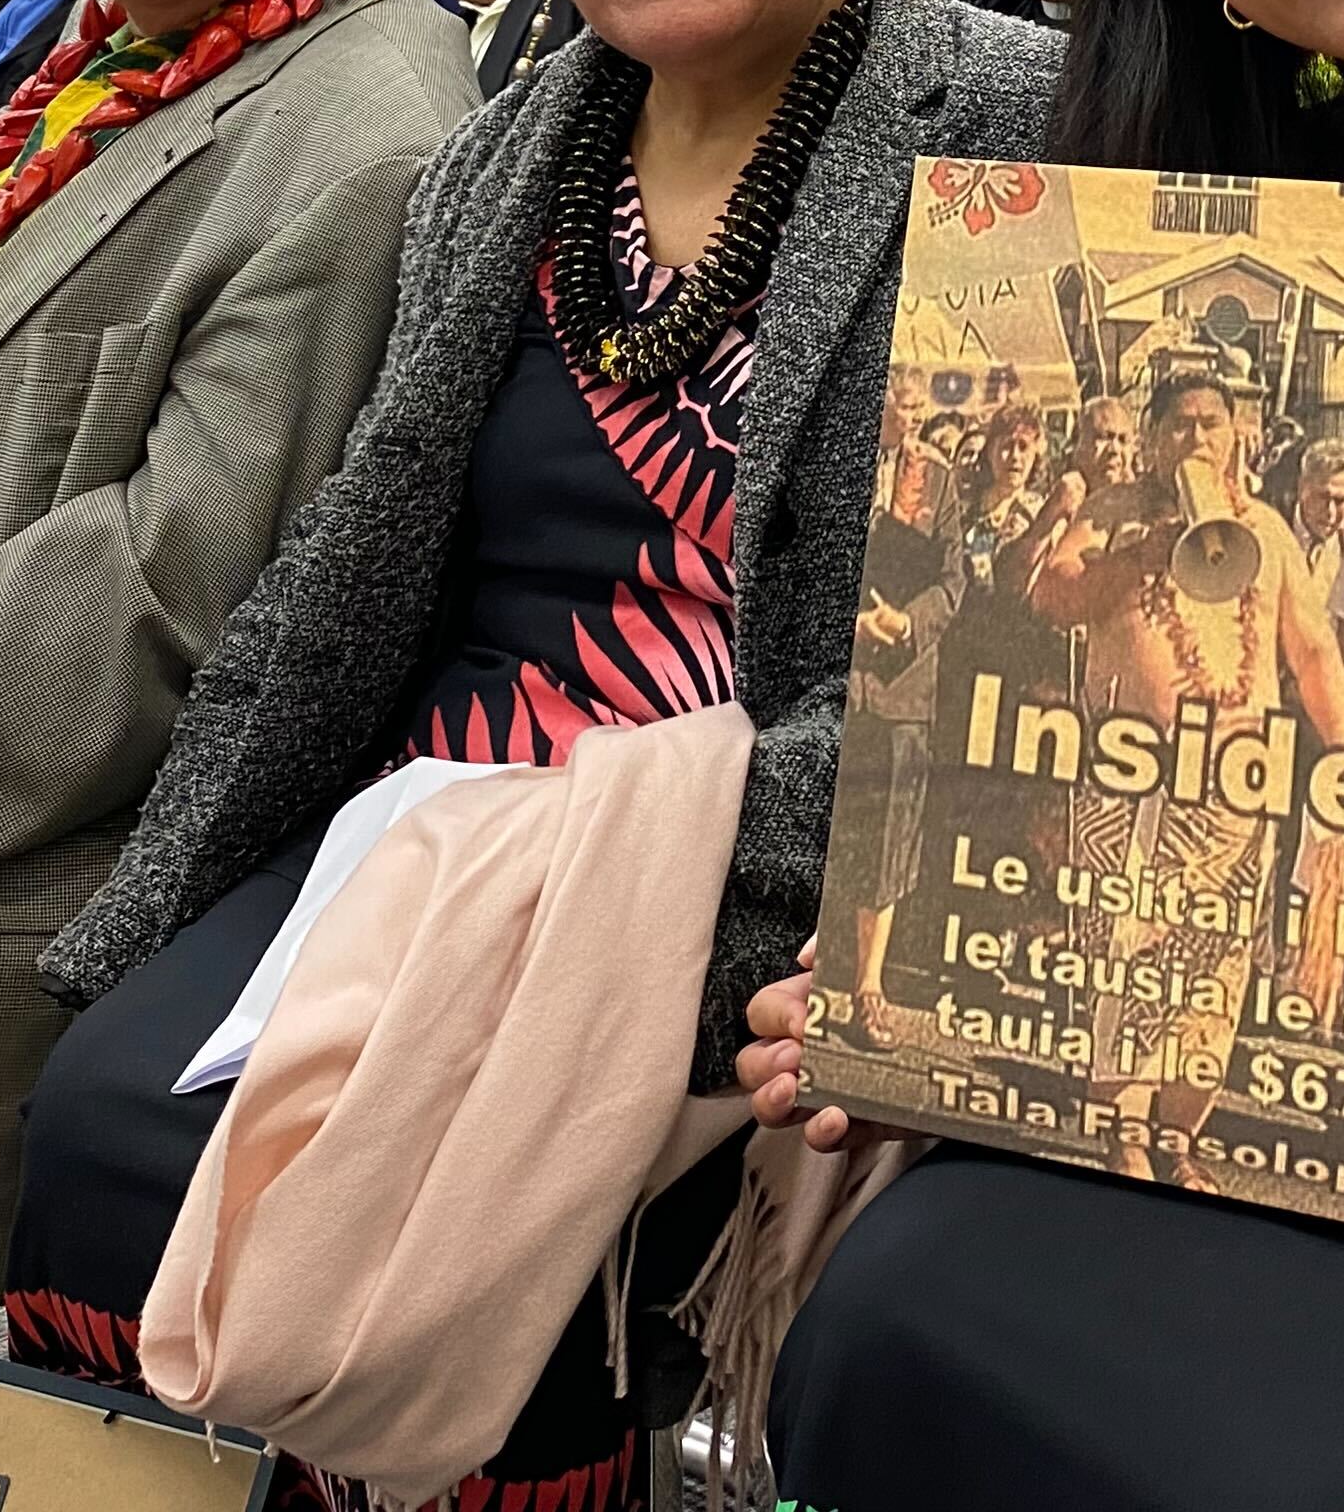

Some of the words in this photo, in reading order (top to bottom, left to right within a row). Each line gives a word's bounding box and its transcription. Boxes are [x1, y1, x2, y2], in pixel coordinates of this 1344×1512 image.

[953, 835, 1028, 894] Le
[1056, 865, 1254, 937] usitai
[1286, 893, 1303, 947] i
[943, 914, 1001, 971] le
[1027, 936, 1227, 1015] tausia
[1255, 977, 1315, 1032] le
[935, 991, 1092, 1065] tauia
[1119, 1026, 1136, 1075] i
[1162, 1034, 1221, 1089] le
[932, 1070, 1056, 1129] Tala
